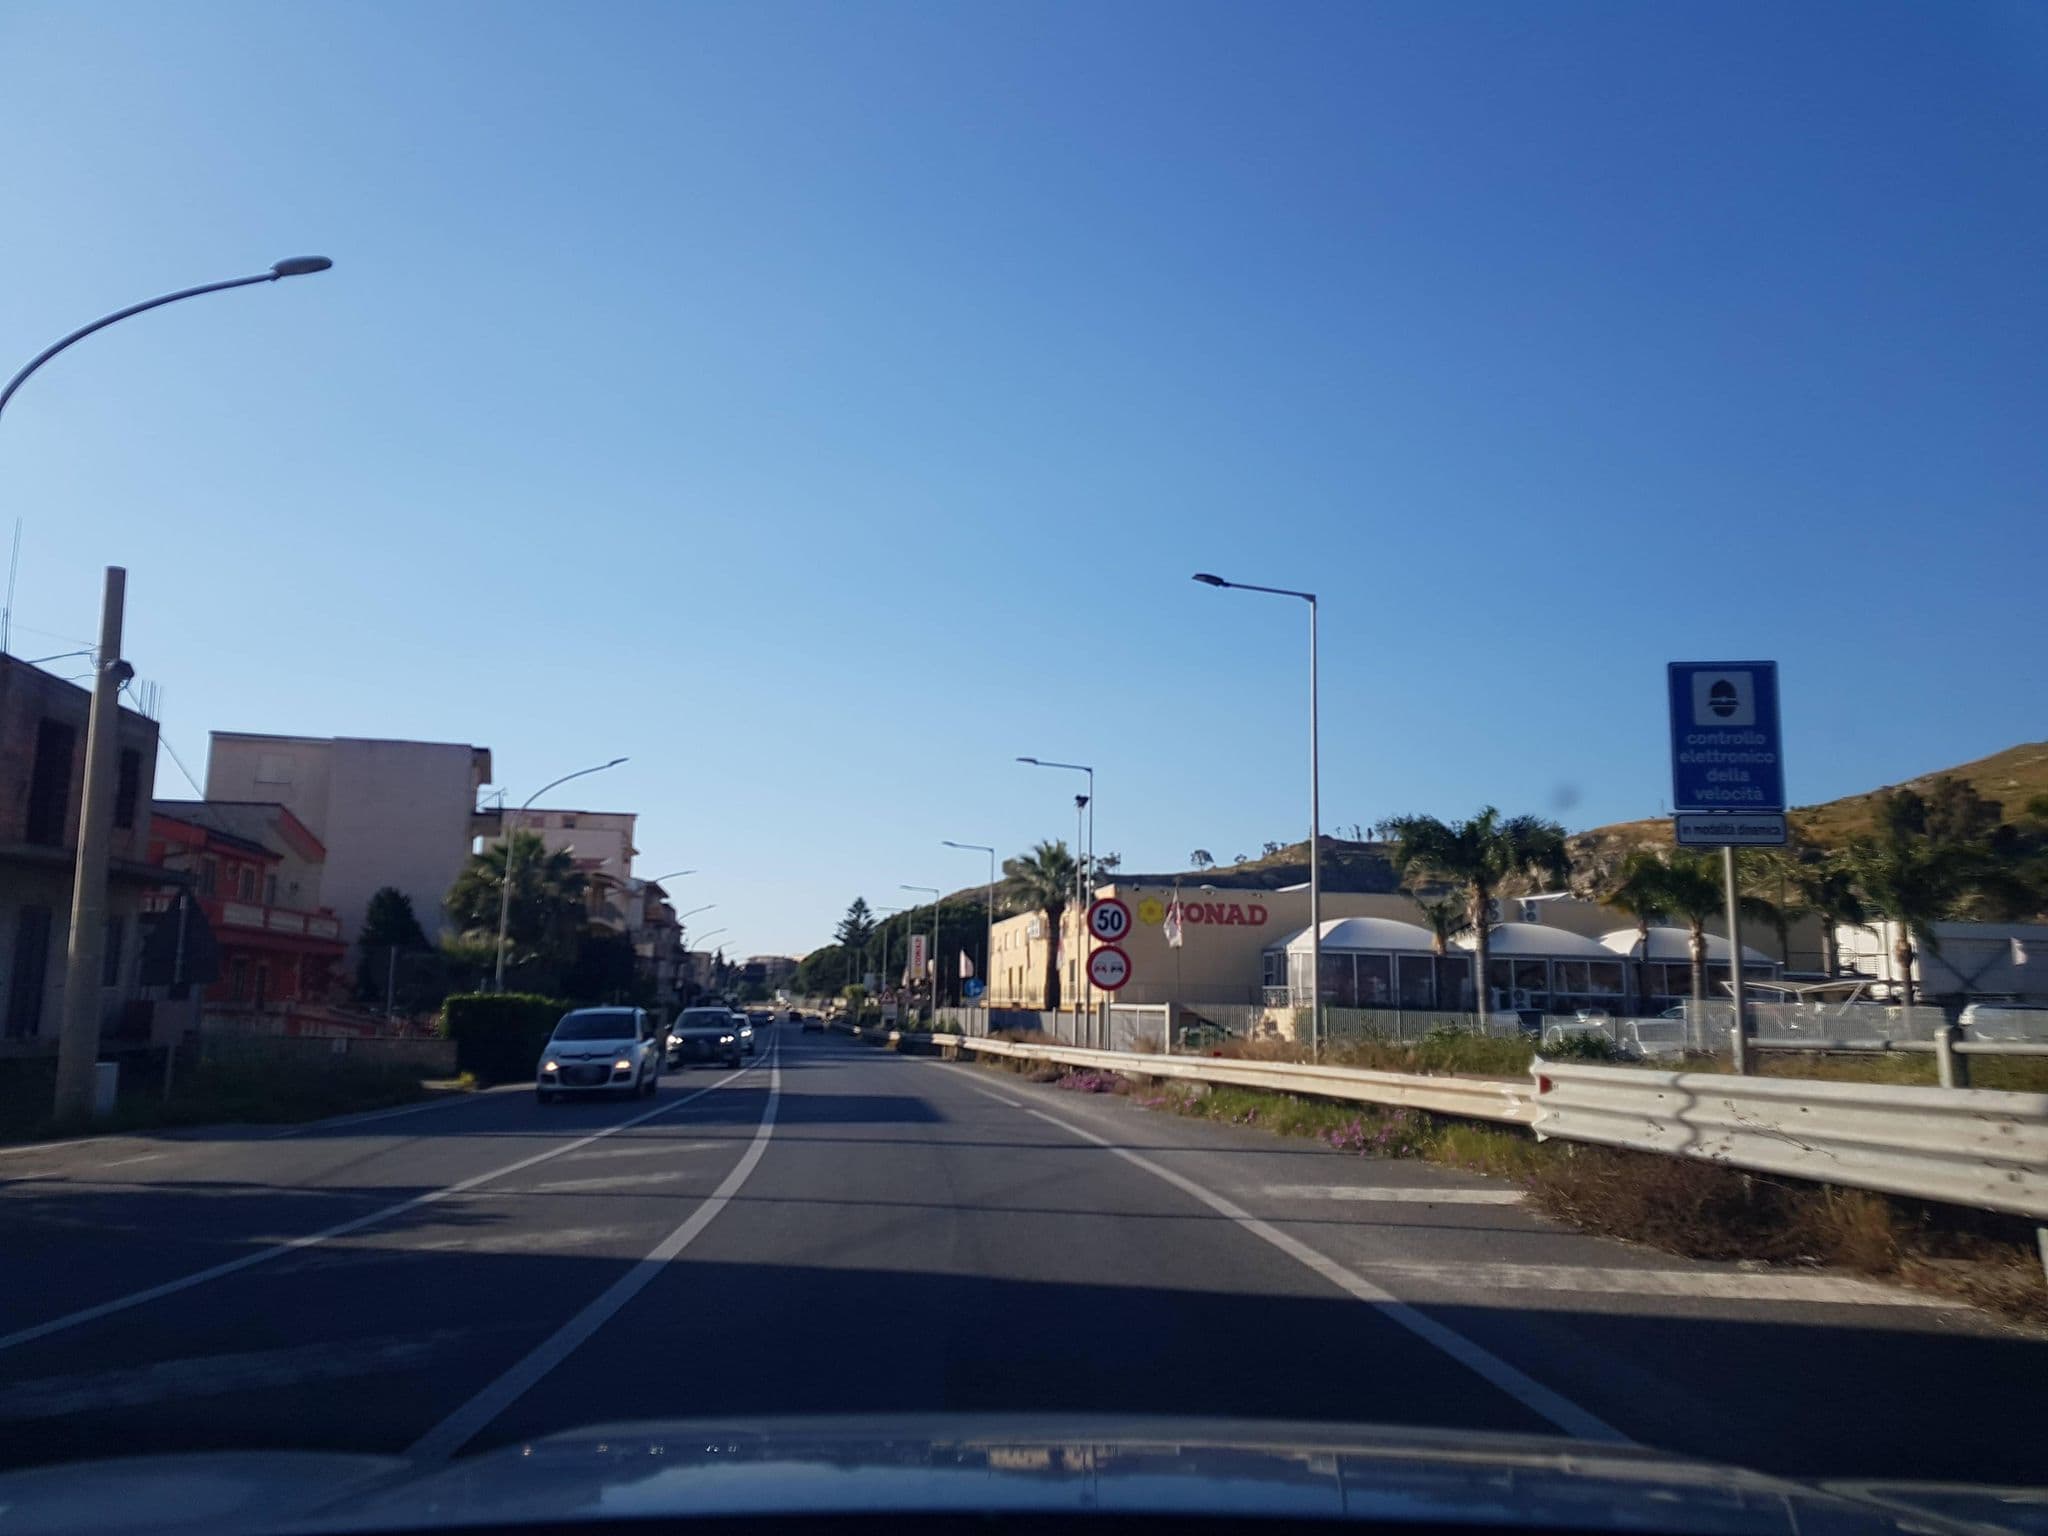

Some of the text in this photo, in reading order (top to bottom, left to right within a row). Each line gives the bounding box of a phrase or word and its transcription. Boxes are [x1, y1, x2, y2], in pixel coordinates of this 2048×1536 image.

[1687, 730, 1766, 745] controllo
[1679, 748, 1777, 763] elettronico
[1706, 767, 1751, 782] della
[1695, 785, 1764, 800] velocità
[1097, 910, 1123, 931] 50
